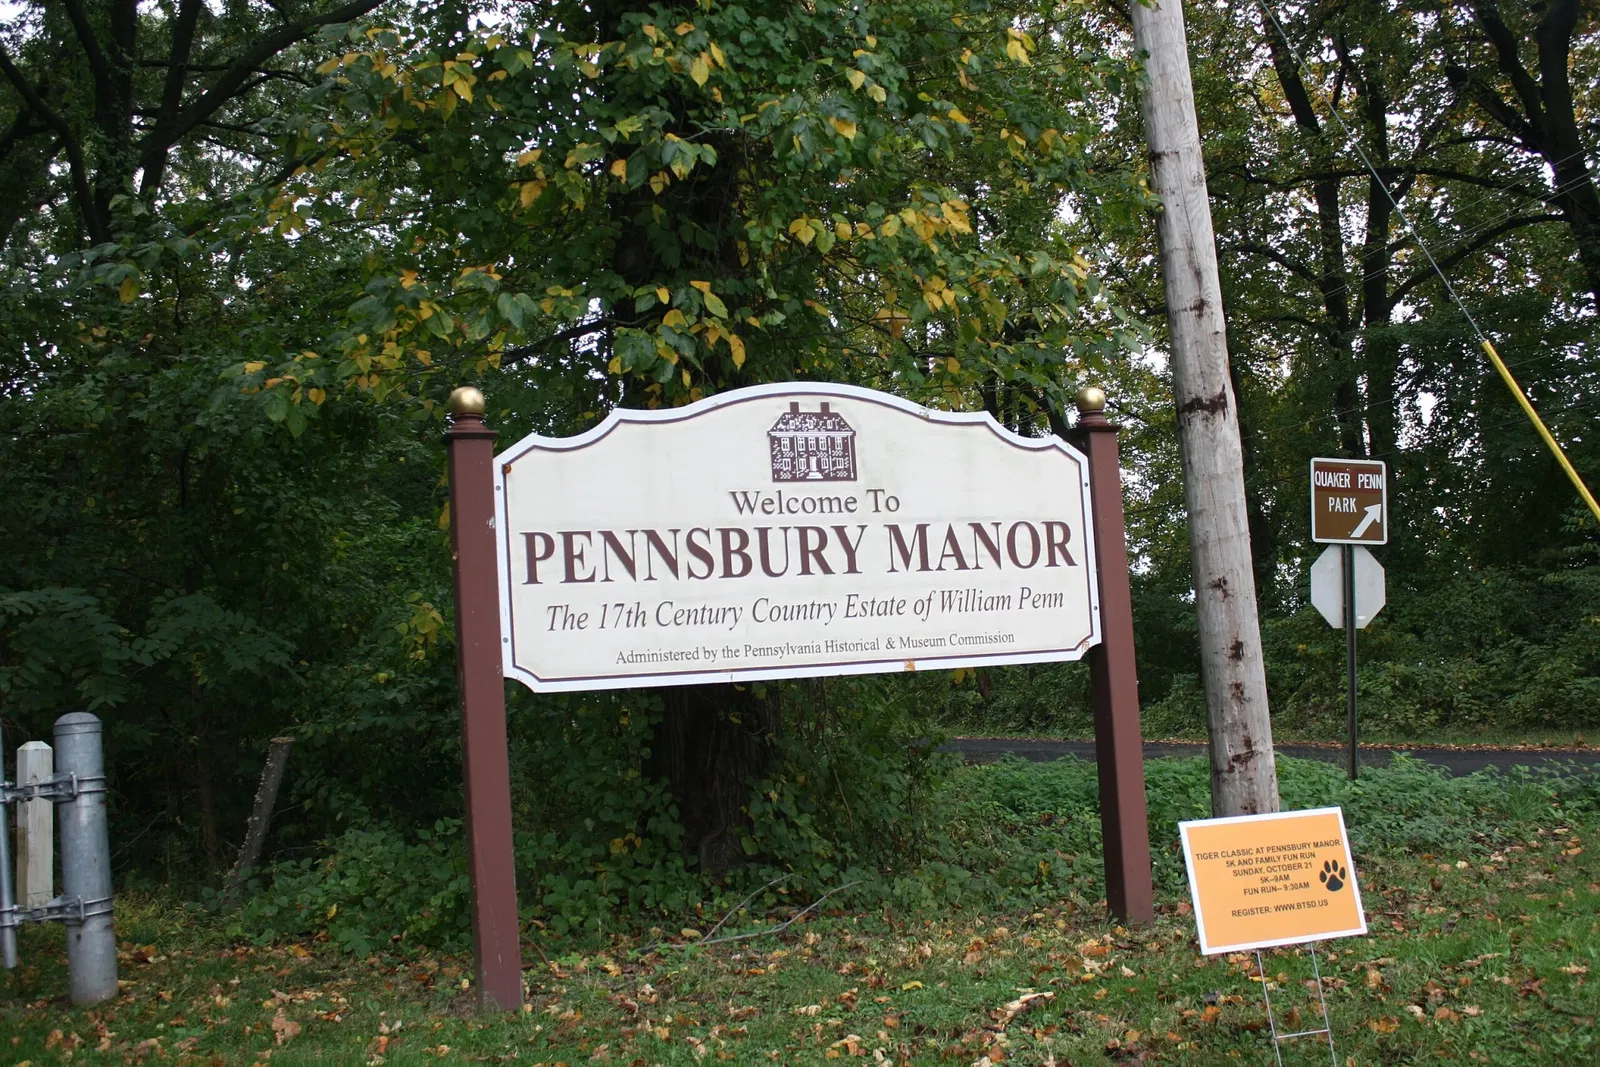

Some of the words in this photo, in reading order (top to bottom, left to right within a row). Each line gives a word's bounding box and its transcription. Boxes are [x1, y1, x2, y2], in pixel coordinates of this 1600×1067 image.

[1315, 471, 1350, 488] QUAKER
[1358, 474, 1382, 489] PENN
[729, 490, 857, 514] Welcome
[866, 489, 900, 513] To
[1329, 497, 1357, 512] PARK
[519, 526, 868, 585] PENNSBURY
[884, 521, 1078, 573] MANOR
[546, 604, 588, 631] The
[598, 602, 646, 629] 17th
[656, 600, 743, 630] Century
[753, 597, 837, 625] Country
[844, 594, 906, 618] Estate
[914, 590, 936, 621] of
[940, 589, 1011, 613] William
[1018, 587, 1064, 609] Penn
[616, 648, 699, 664] Administered
[703, 646, 717, 661] by
[722, 646, 740, 658] the
[744, 642, 821, 659] Pennsylvania
[825, 638, 879, 653] Historical
[886, 638, 895, 649] &
[899, 636, 946, 648] Museum
[949, 631, 1014, 645] Commission
[1196, 852, 1219, 860] TIGER
[1221, 848, 1253, 857] CLASSIC
[1266, 842, 1311, 853] PENNSBURY
[1313, 839, 1340, 848] MANOR
[1238, 858, 1253, 866] AND
[1256, 855, 1281, 864] FAMILY
[1283, 853, 1298, 861] FUN
[1267, 863, 1302, 873] OCTOBER
[1243, 887, 1259, 895] FUN
[1284, 882, 1309, 891] 9:30AM
[1232, 907, 1272, 917] REGISTER:
[1274, 899, 1328, 912] WWW.BTSD.US
